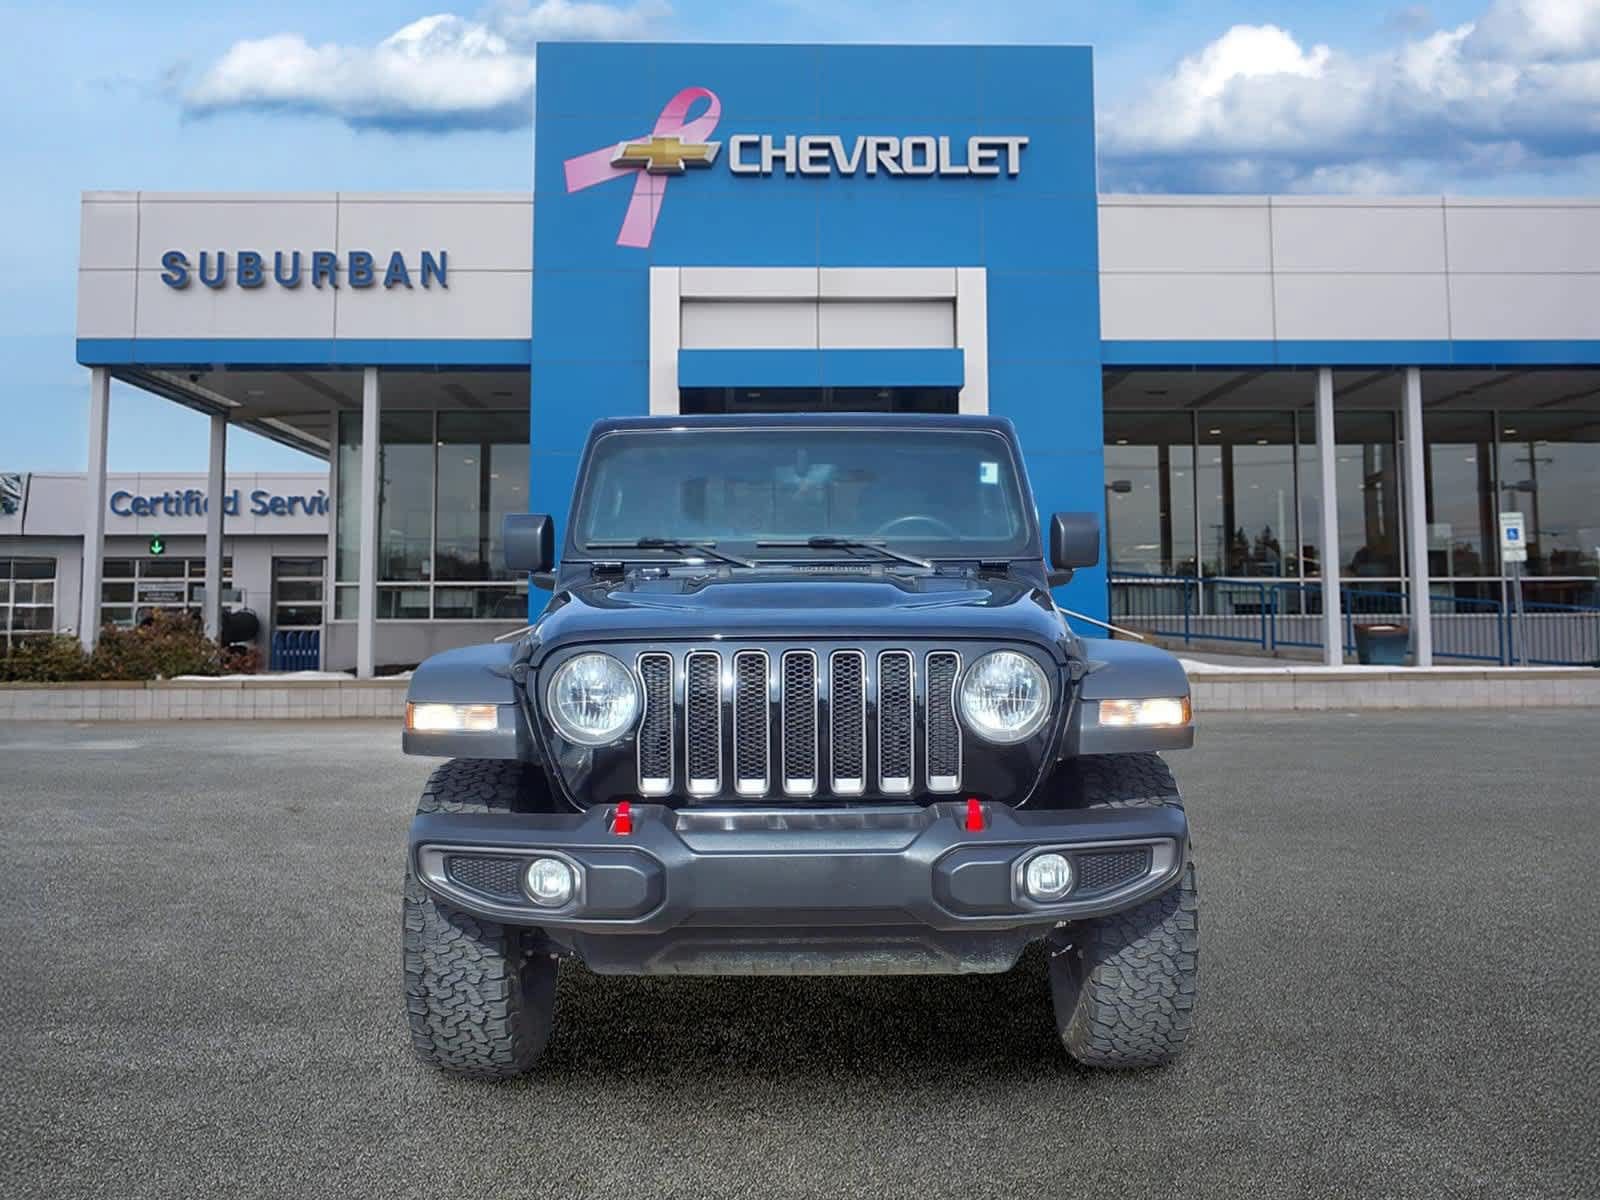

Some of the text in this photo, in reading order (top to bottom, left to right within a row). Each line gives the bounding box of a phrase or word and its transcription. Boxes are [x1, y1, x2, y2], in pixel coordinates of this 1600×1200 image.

[729, 135, 1029, 174] CHEVROLET
[161, 250, 449, 289] SUBURBAN
[110, 489, 240, 517] Certifid
